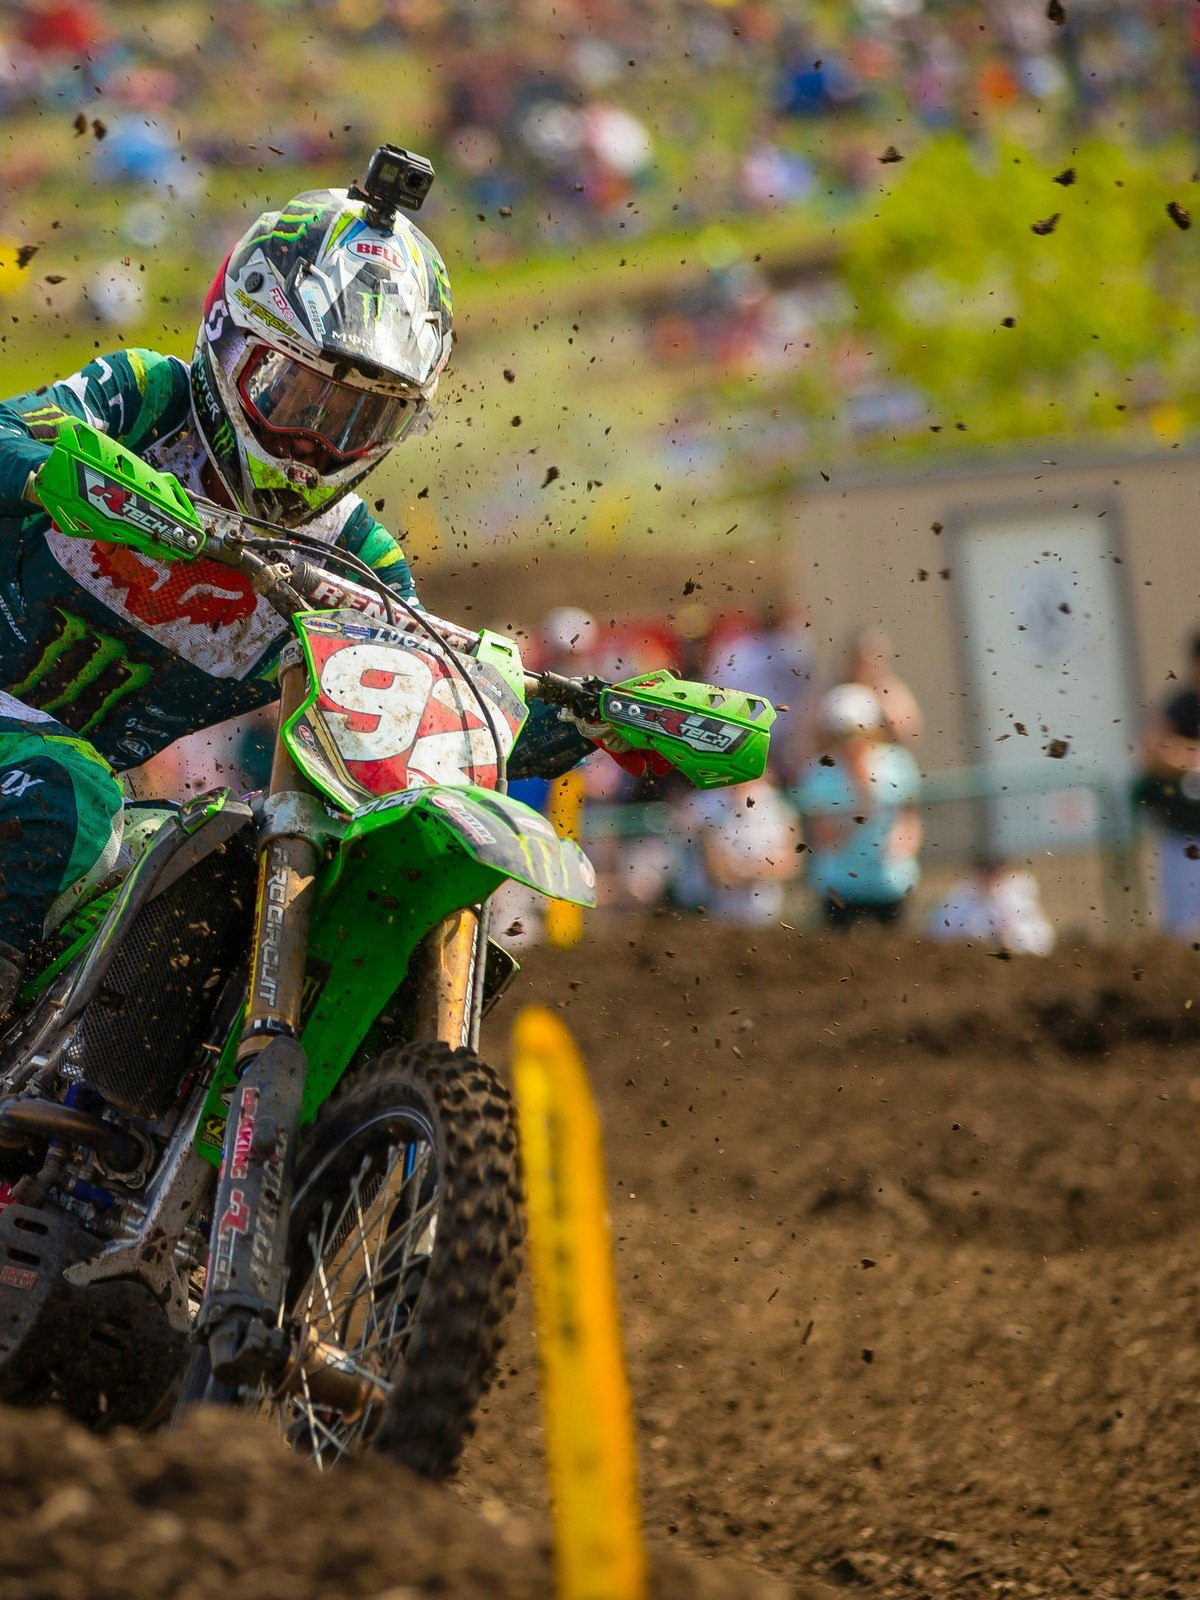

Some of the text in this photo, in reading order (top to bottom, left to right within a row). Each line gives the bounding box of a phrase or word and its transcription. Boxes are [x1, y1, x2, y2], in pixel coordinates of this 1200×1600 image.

[356, 243, 401, 268] BELL
[319, 644, 514, 790] 92
[258, 903, 286, 1006] CIRCUIT
[230, 1087, 259, 1179] BRAKING
